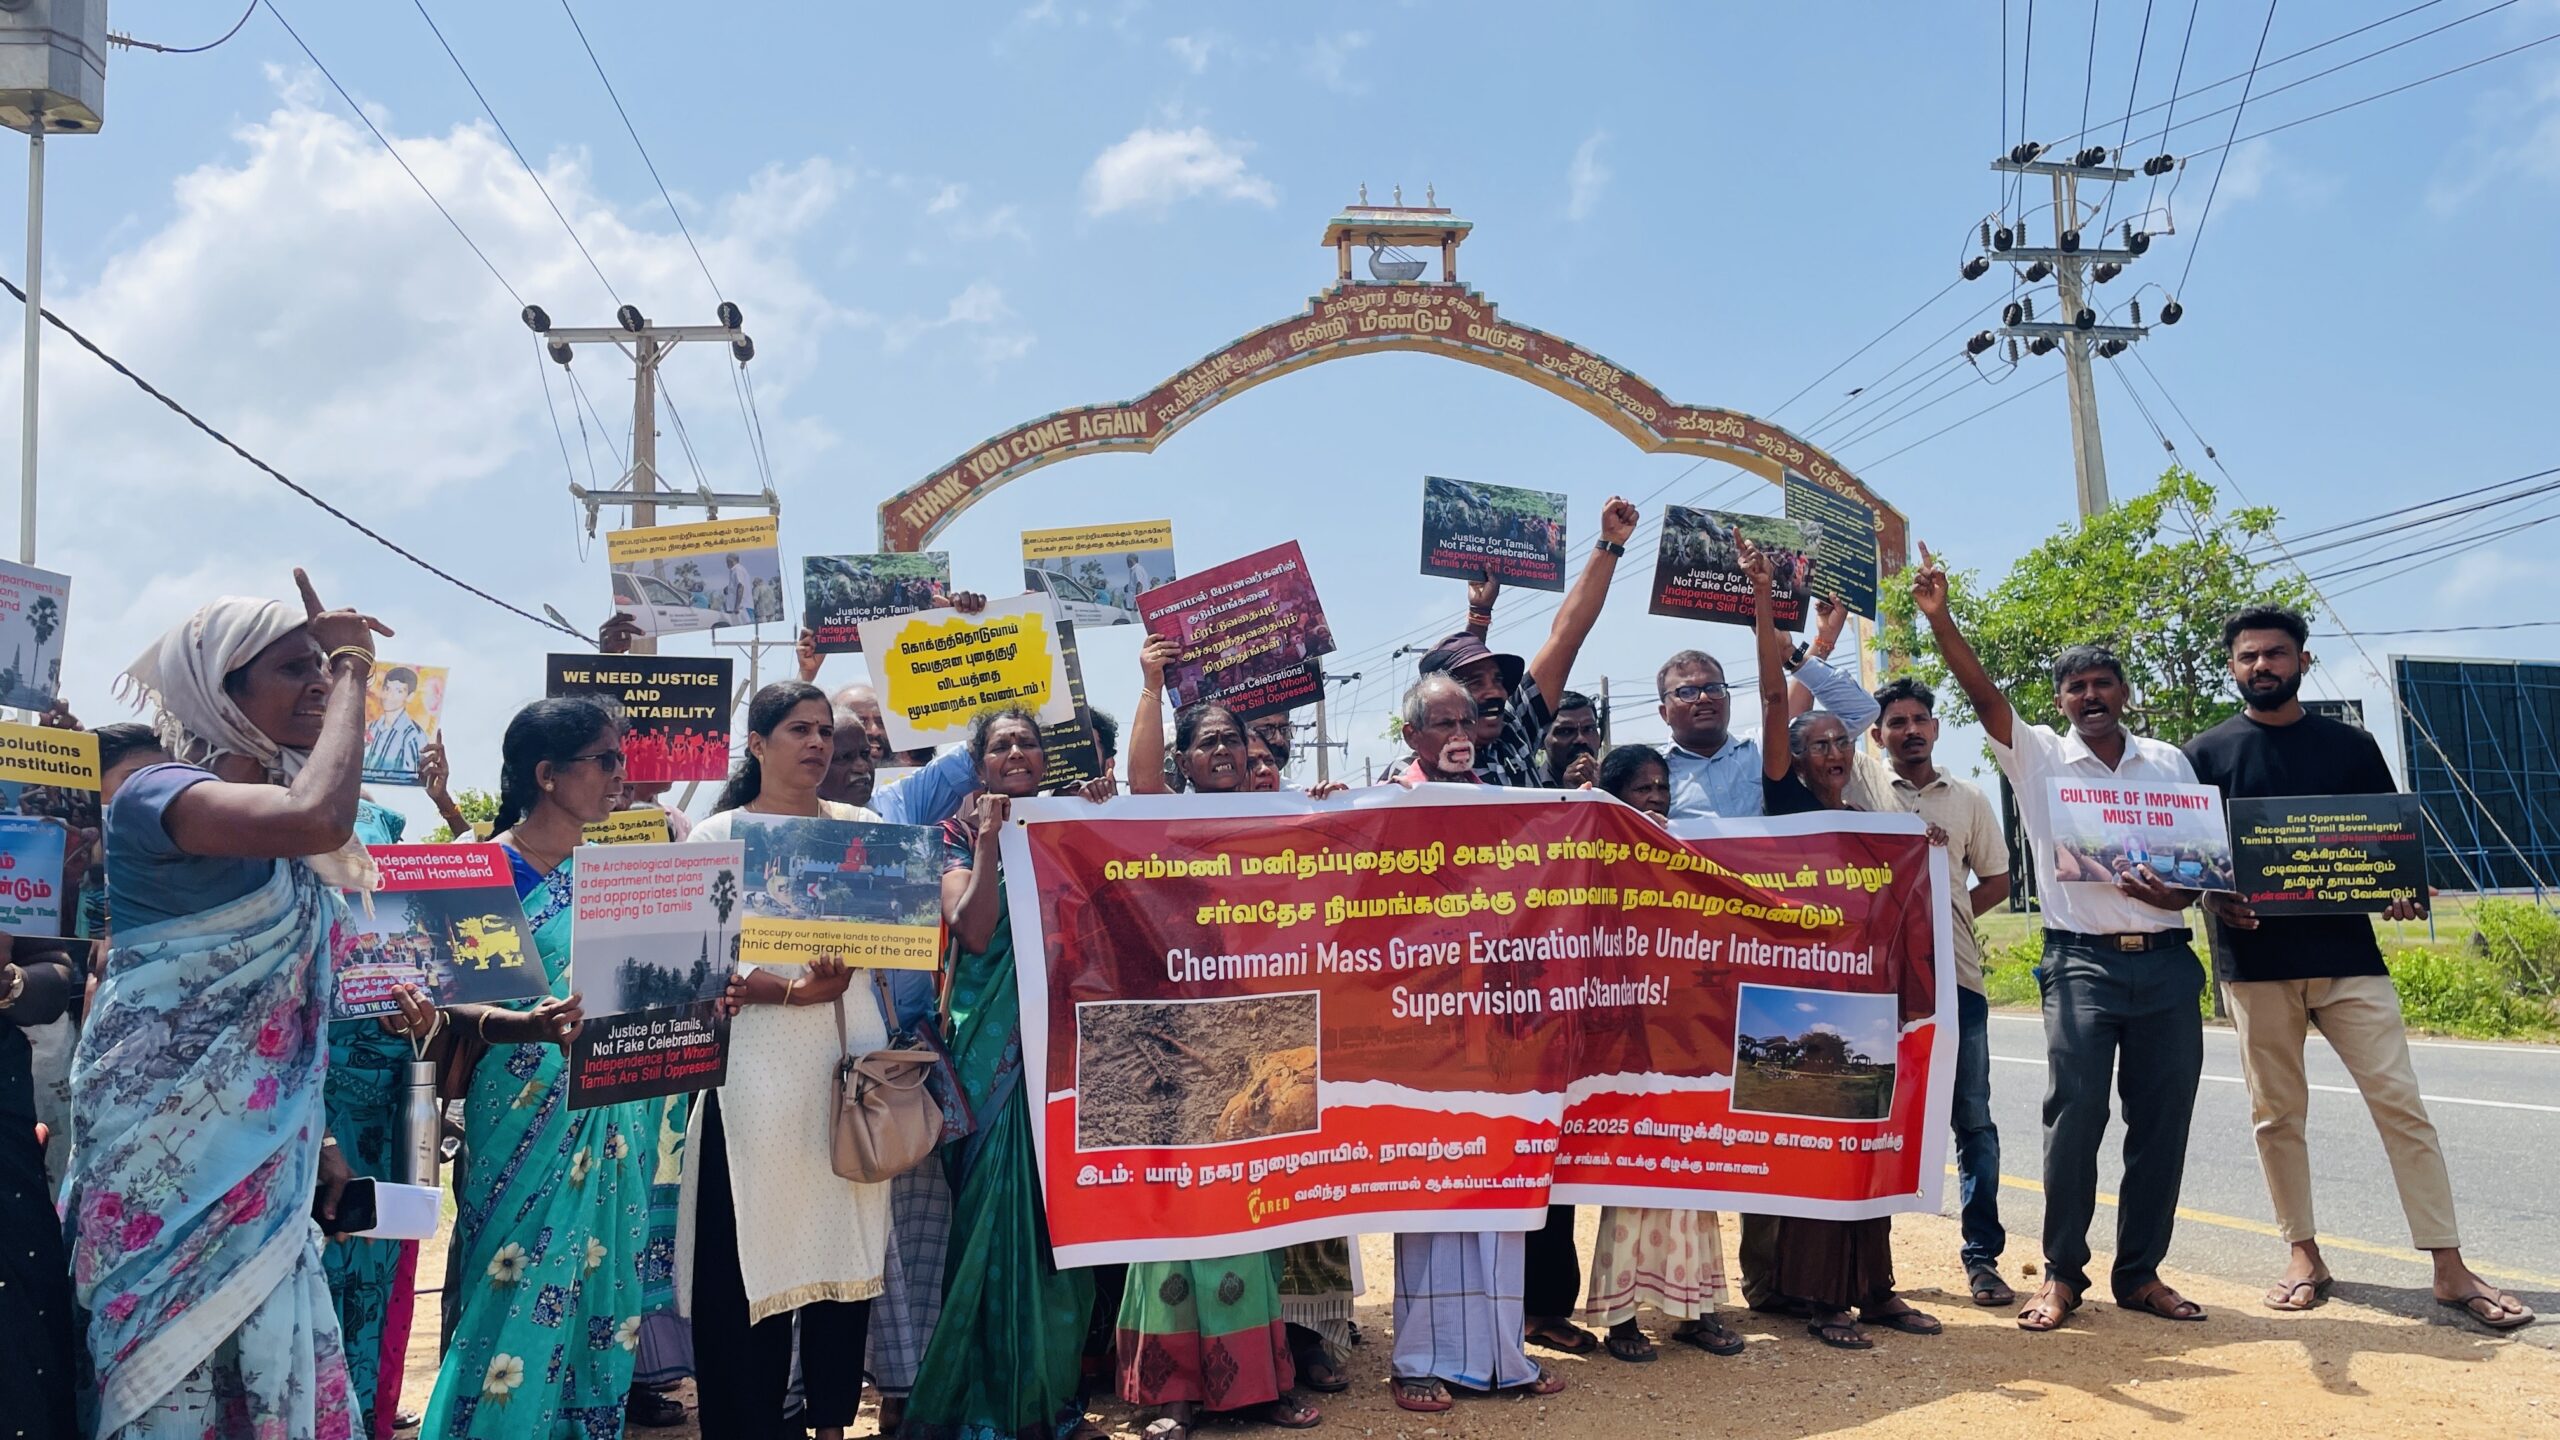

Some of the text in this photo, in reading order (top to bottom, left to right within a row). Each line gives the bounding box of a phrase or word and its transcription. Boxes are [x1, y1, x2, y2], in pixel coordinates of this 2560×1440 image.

[1393, 291, 1443, 307] பிரதேச
[1289, 308, 1526, 351] நன்றி மீண்டும் வருக
[1157, 347, 1276, 423] PRADESHIYA SABHA
[1173, 353, 1233, 395] NALLUR
[900, 411, 1147, 529] THANK YOU COME AGAIN
[1452, 532, 1501, 546] Justice for
[1433, 548, 1556, 570] Independence Whom?
[1439, 539, 1549, 562] Not Fake Celebrations!
[1430, 556, 1557, 580] Tamils Oppressed!
[1687, 568, 1725, 581] Justice
[1727, 572, 1742, 583] for
[1149, 559, 1297, 621] காணாமல் போனவர்களின்
[1665, 585, 1738, 603] Independence
[1673, 576, 1720, 591] Not Fake
[1187, 587, 1270, 625] குடும்பங்களை
[1660, 595, 1736, 612] Tamils Are Still
[1189, 601, 1279, 642] மிரட்டுவதையும்
[901, 622, 1019, 656] கொக்குத்தொடுவாய்
[1181, 612, 1298, 662] அச்சுறுத்துவதையும்
[911, 642, 1018, 675] வெகுஜன புதைகுழி
[563, 671, 719, 686] WE NEED JUSTICE
[937, 669, 1001, 692] விடயத்தை
[1247, 664, 1305, 688] Celebrations!
[1280, 672, 1312, 689] Whom?
[624, 690, 660, 701] AND
[1249, 682, 1317, 709] Still Oppressed!
[907, 696, 978, 721] மூடிமறைக்க
[0, 737, 80, 757] solutions
[2060, 788, 2209, 811] CULTURE OF IMPUNITY
[2103, 809, 2174, 827] MUST END
[2255, 822, 2402, 835] Recognize Tamil Sovereignty!
[2287, 813, 2367, 824] End Oppression
[2240, 835, 2316, 845] Tamils Demand
[374, 852, 489, 868] ndependence day
[582, 855, 739, 873] The Archeological Department is
[1104, 836, 1893, 894] செம்மணி மனிதப்புதைகுழி அகழ்வு சர்வதேச மற்றும்
[2292, 848, 2367, 862] ஆக்கிரமிப்பு
[388, 868, 424, 881] Tamil
[427, 866, 493, 879] Homeland
[2262, 860, 2396, 876] முடிவடைய வேண்டும்
[591, 872, 703, 889] department that plans
[2283, 874, 2376, 890] தமிழர் தாயகம்
[580, 884, 704, 905] and appropriates land
[2318, 890, 2347, 903] பெற
[580, 901, 693, 921] belonging to Tamils
[1196, 894, 1316, 929] சர்வதேச
[1324, 887, 1517, 926] நியமங்களுக்கு
[1524, 886, 1617, 909] அமைவாக
[758, 929, 793, 939] occupy
[812, 932, 842, 940] native
[843, 932, 869, 942] lands
[881, 935, 916, 945] change
[773, 940, 933, 958] demographic of the area
[1166, 925, 1873, 983] Chemmani Mass Grave Excavation Must Be Under International
[1392, 975, 1670, 1026] Supervision and Standards!
[608, 1018, 703, 1040] Justice for Tamils,
[593, 1030, 715, 1056] Not Fake Celebrations!
[585, 1043, 721, 1073] Independence for Whom?
[580, 1058, 721, 1089] Tamils Are Still Oppressed!
[1076, 1116, 1904, 1187] இடம்: யாழ் நகர நுழைவாயில், நாவற்குளி வியாழக்கிழமை காலை 10 மணிக்கு
[1294, 1154, 1770, 1201] வலிந்து காணாமல் வடக்கு கிழக்கு மாகாணம்
